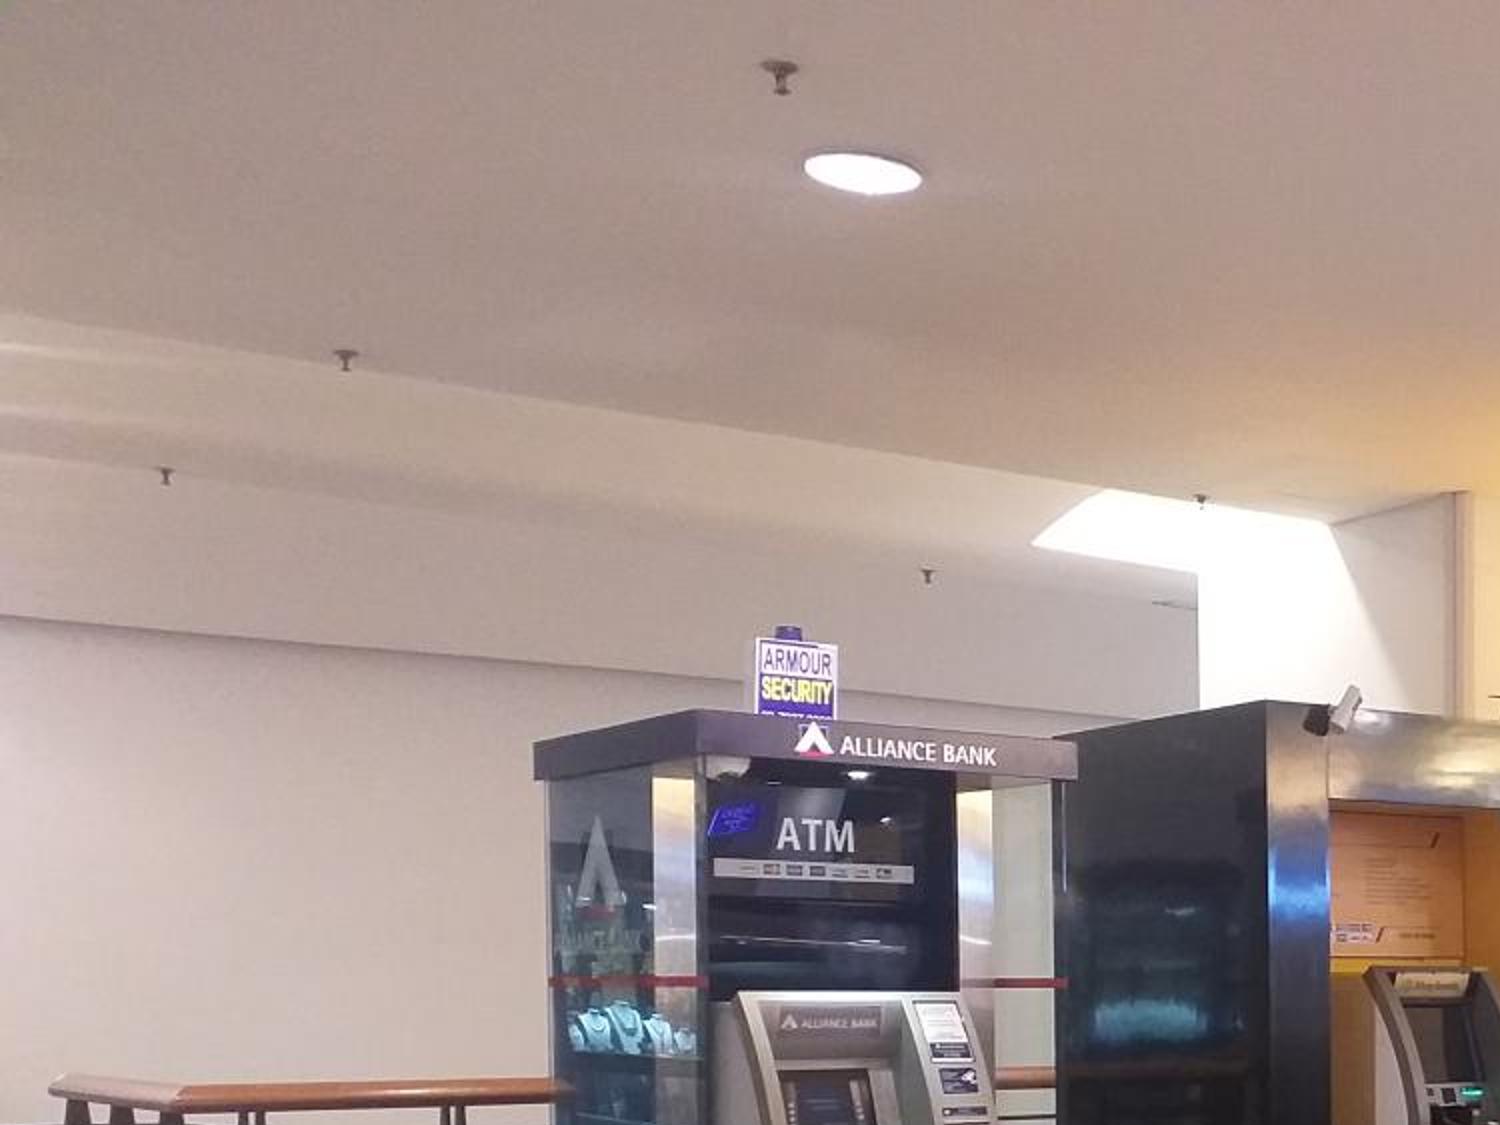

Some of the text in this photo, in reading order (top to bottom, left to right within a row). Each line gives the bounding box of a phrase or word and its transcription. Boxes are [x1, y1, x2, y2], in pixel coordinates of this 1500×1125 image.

[763, 648, 831, 675] ARMOUR
[761, 676, 833, 705] SECURITY
[840, 736, 997, 766] ALLIANCE BANK
[776, 817, 855, 852] ATM
